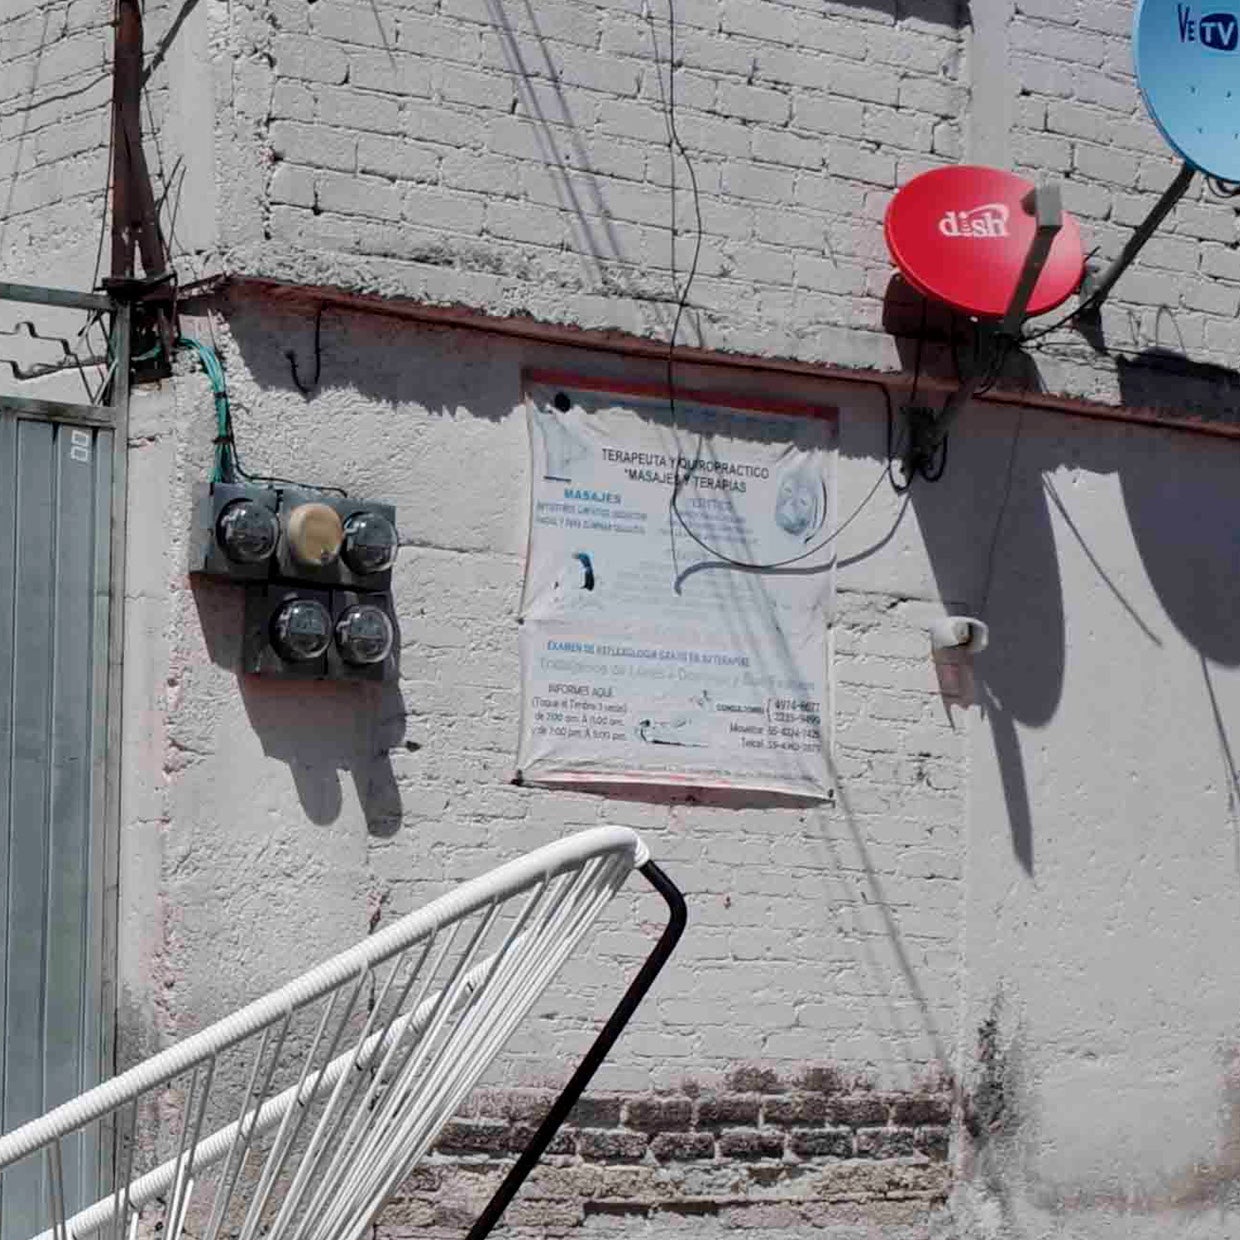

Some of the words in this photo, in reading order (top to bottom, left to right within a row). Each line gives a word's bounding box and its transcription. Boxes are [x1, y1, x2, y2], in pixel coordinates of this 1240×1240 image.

[939, 203, 1010, 238] dish
[602, 448, 667, 469] TERAPEUTA
[693, 475, 747, 493] TERAPIAS
[564, 489, 621, 504] MASAJES
